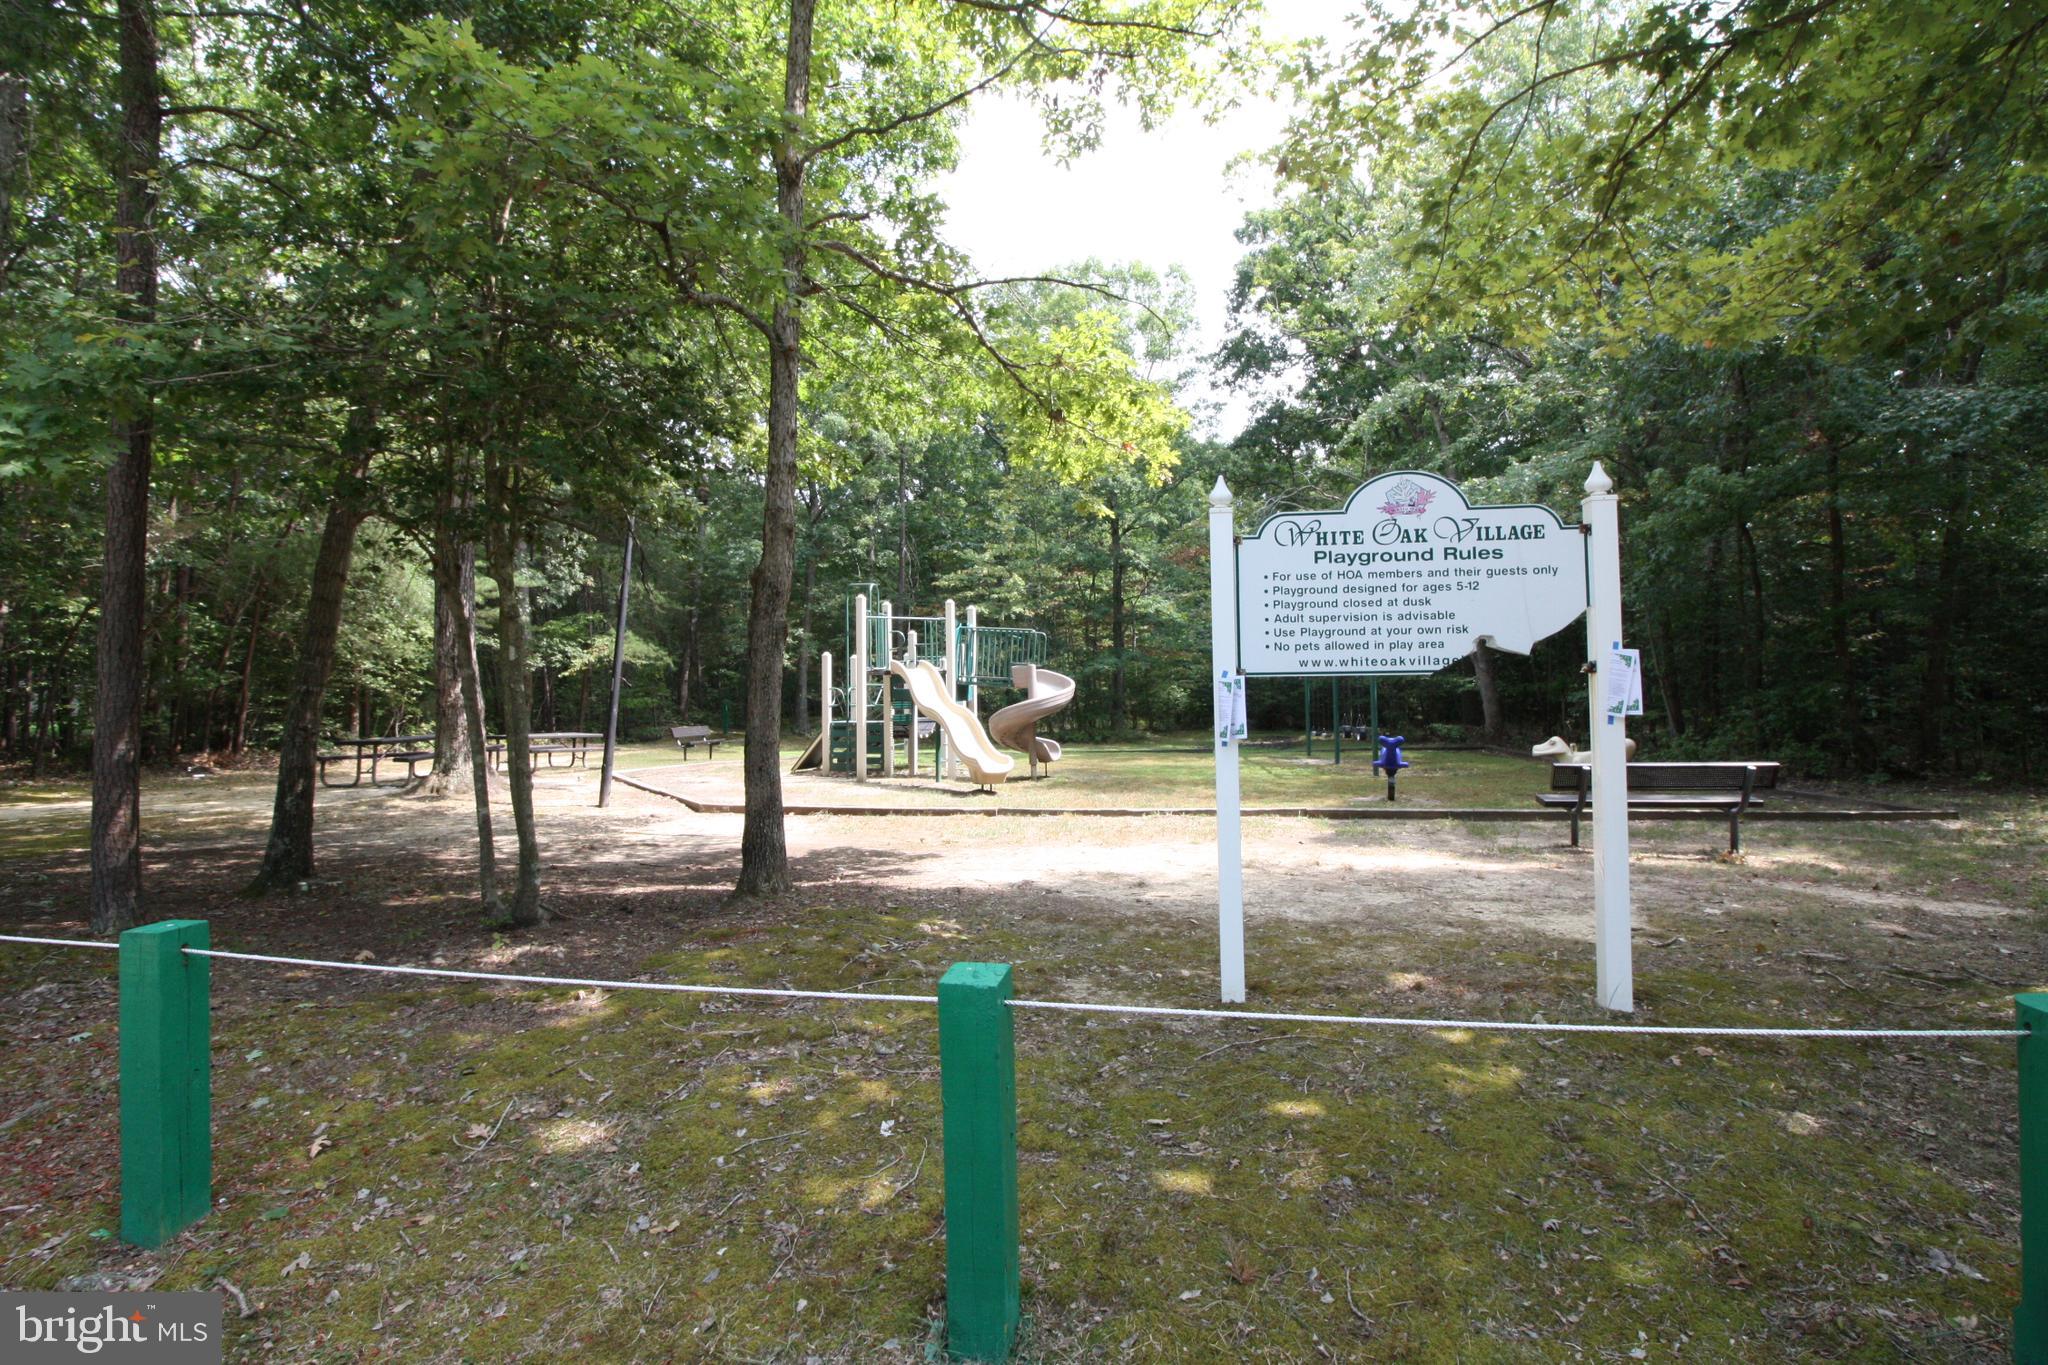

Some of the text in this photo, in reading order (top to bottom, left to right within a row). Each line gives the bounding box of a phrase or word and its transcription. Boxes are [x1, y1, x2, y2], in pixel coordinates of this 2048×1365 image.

[1372, 519, 1428, 546] OAK
[1433, 516, 1545, 543] VILLAGE
[1314, 546, 1504, 566] Playground Rules
[1272, 564, 1559, 581] For use of HOA members and their guests only
[1272, 580, 1480, 598] Playground designed for ages 5-12
[1273, 596, 1432, 612] Playground closed at dusk
[1274, 610, 1456, 624] Adult supervision is advisable
[1273, 624, 1470, 639] Use Playground at your own risk
[1274, 640, 1445, 654] No pets allowed in play area
[1299, 655, 1463, 668] www.whiteoakvillage
